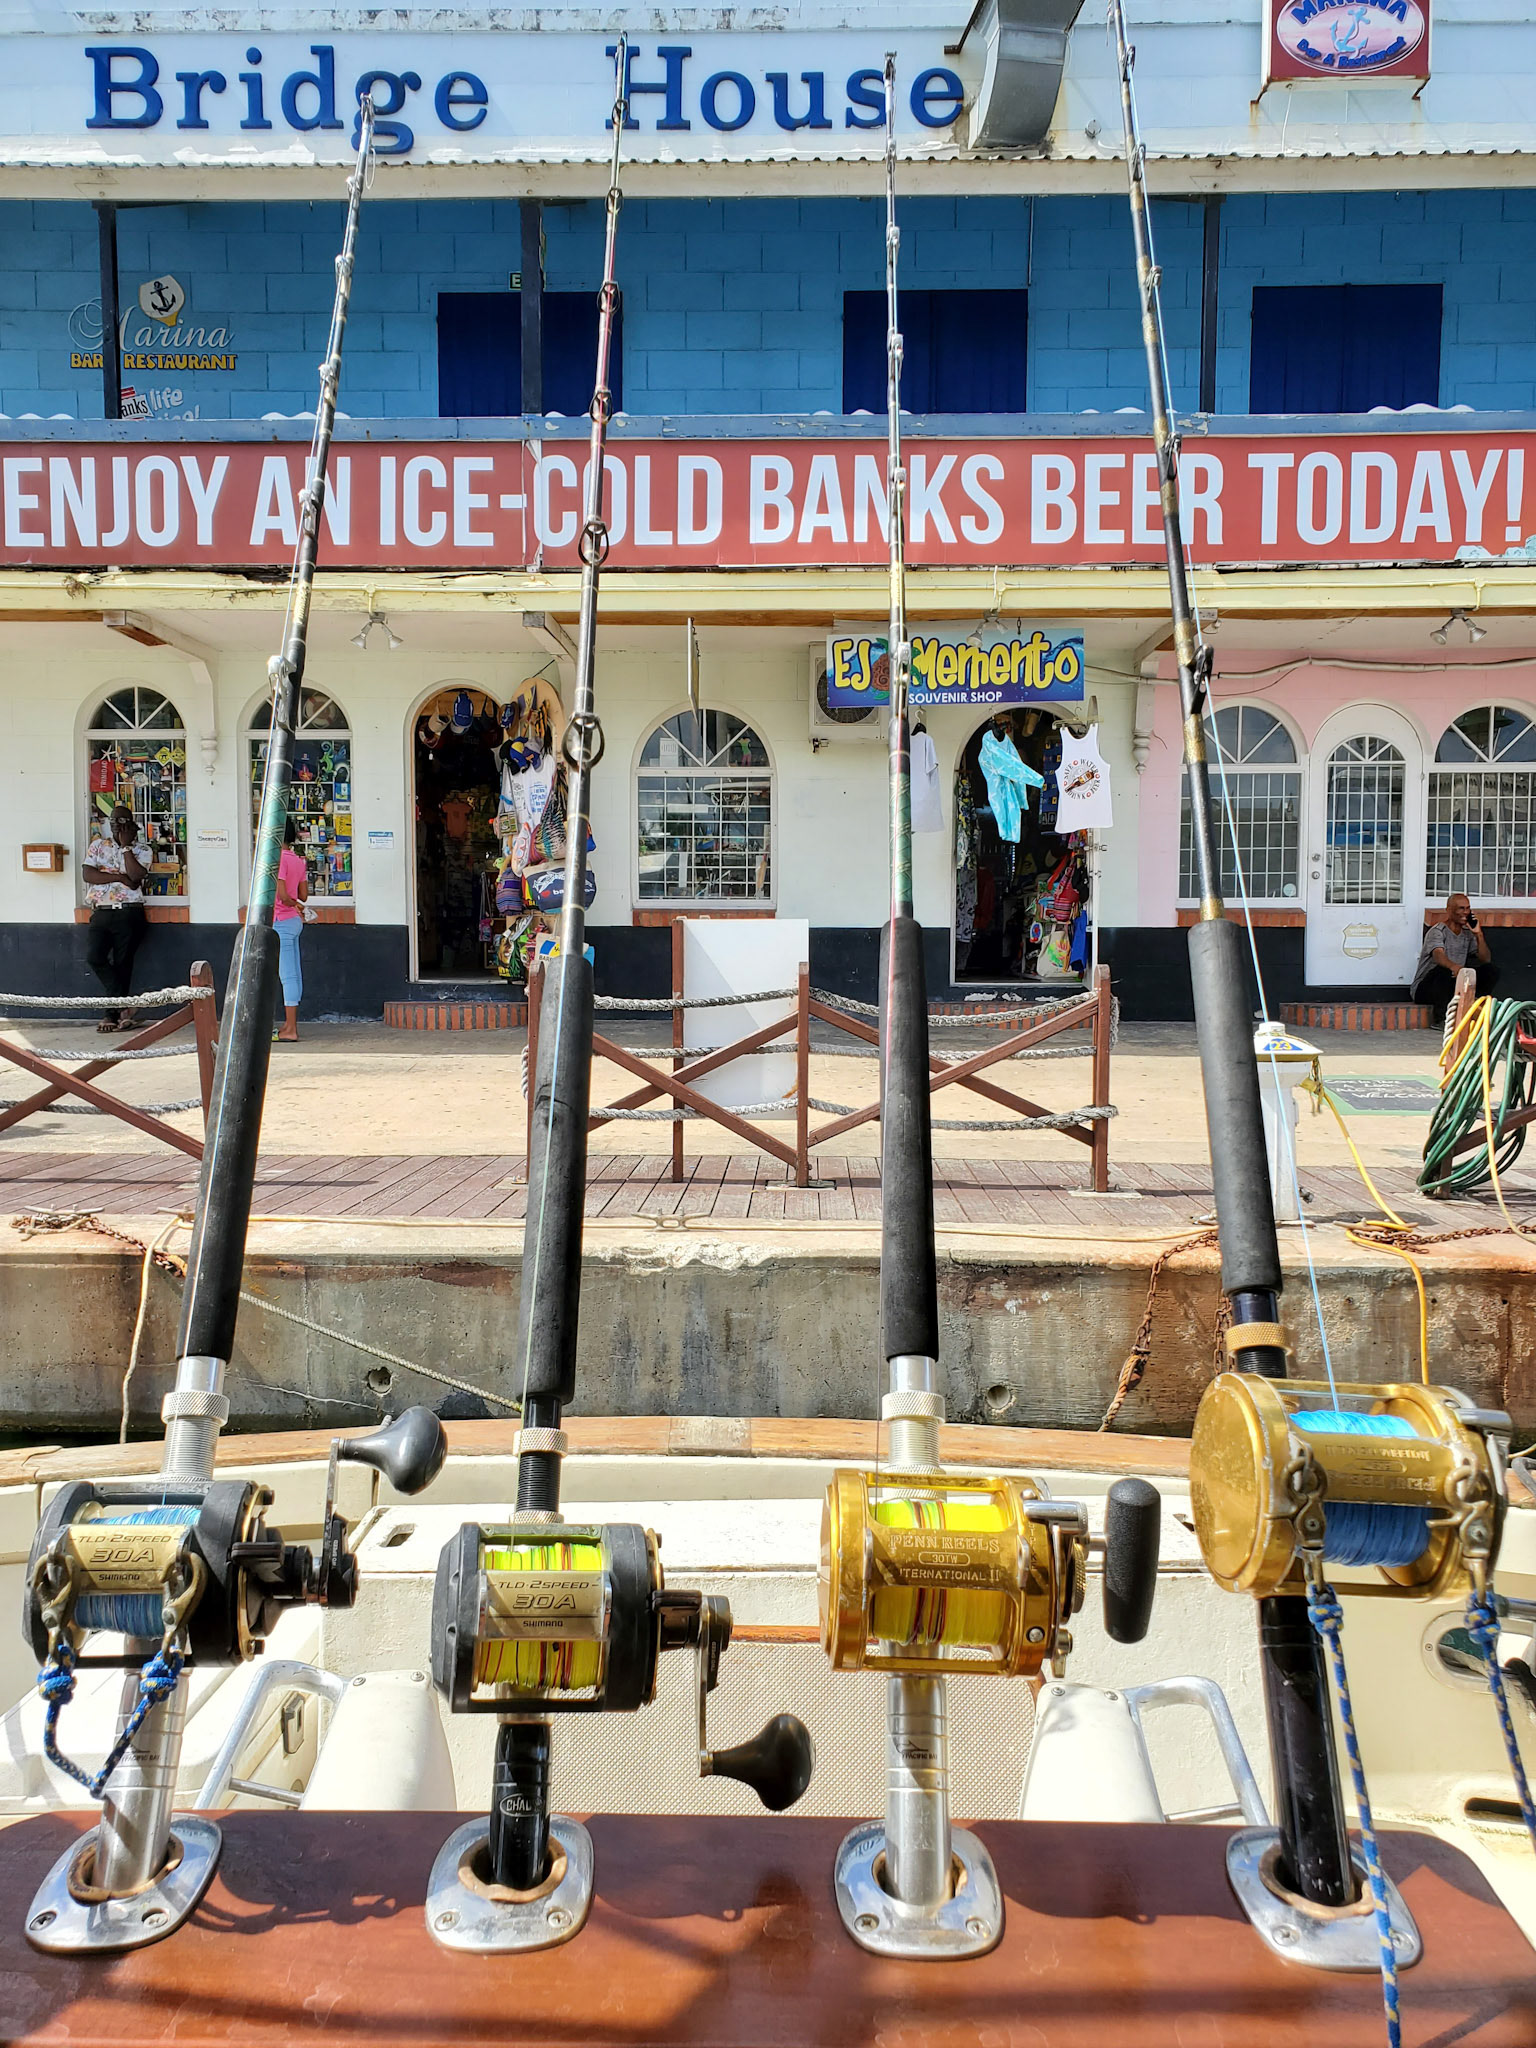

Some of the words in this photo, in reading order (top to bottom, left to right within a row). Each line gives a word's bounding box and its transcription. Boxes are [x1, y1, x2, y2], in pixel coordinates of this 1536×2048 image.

[1297, 38, 1321, 59] Bar
[1323, 53, 1335, 66] &
[1338, 36, 1407, 68] Restaurant
[85, 46, 489, 153] Bridge
[605, 46, 963, 131] House
[71, 353, 103, 369] BAR
[124, 353, 238, 370] RESTAURANT
[121, 398, 149, 418] anks
[150, 387, 185, 411] life
[3, 455, 229, 547] ENJOY
[250, 455, 351, 546] AN
[380, 455, 723, 547] ICE-COLD
[750, 454, 1005, 545] BANKS
[1031, 453, 1224, 545] BEER
[1248, 449, 1525, 545] TODAY!
[832, 639, 871, 691] EJ
[910, 631, 1080, 690] Memento
[908, 691, 967, 705] SOUVENIR
[970, 690, 1003, 702] SHOP
[100, 760, 108, 789] TRINIDAD
[1271, 1040, 1292, 1050] 23
[890, 1534, 937, 1550] PENN
[942, 1536, 1000, 1554] REELS
[89, 1547, 155, 1563] 30A
[931, 1554, 958, 1564] 30TW
[98, 1573, 141, 1581] SHIMANO
[900, 1568, 986, 1581] TERNATIONAL
[512, 1593, 576, 1609] 30A
